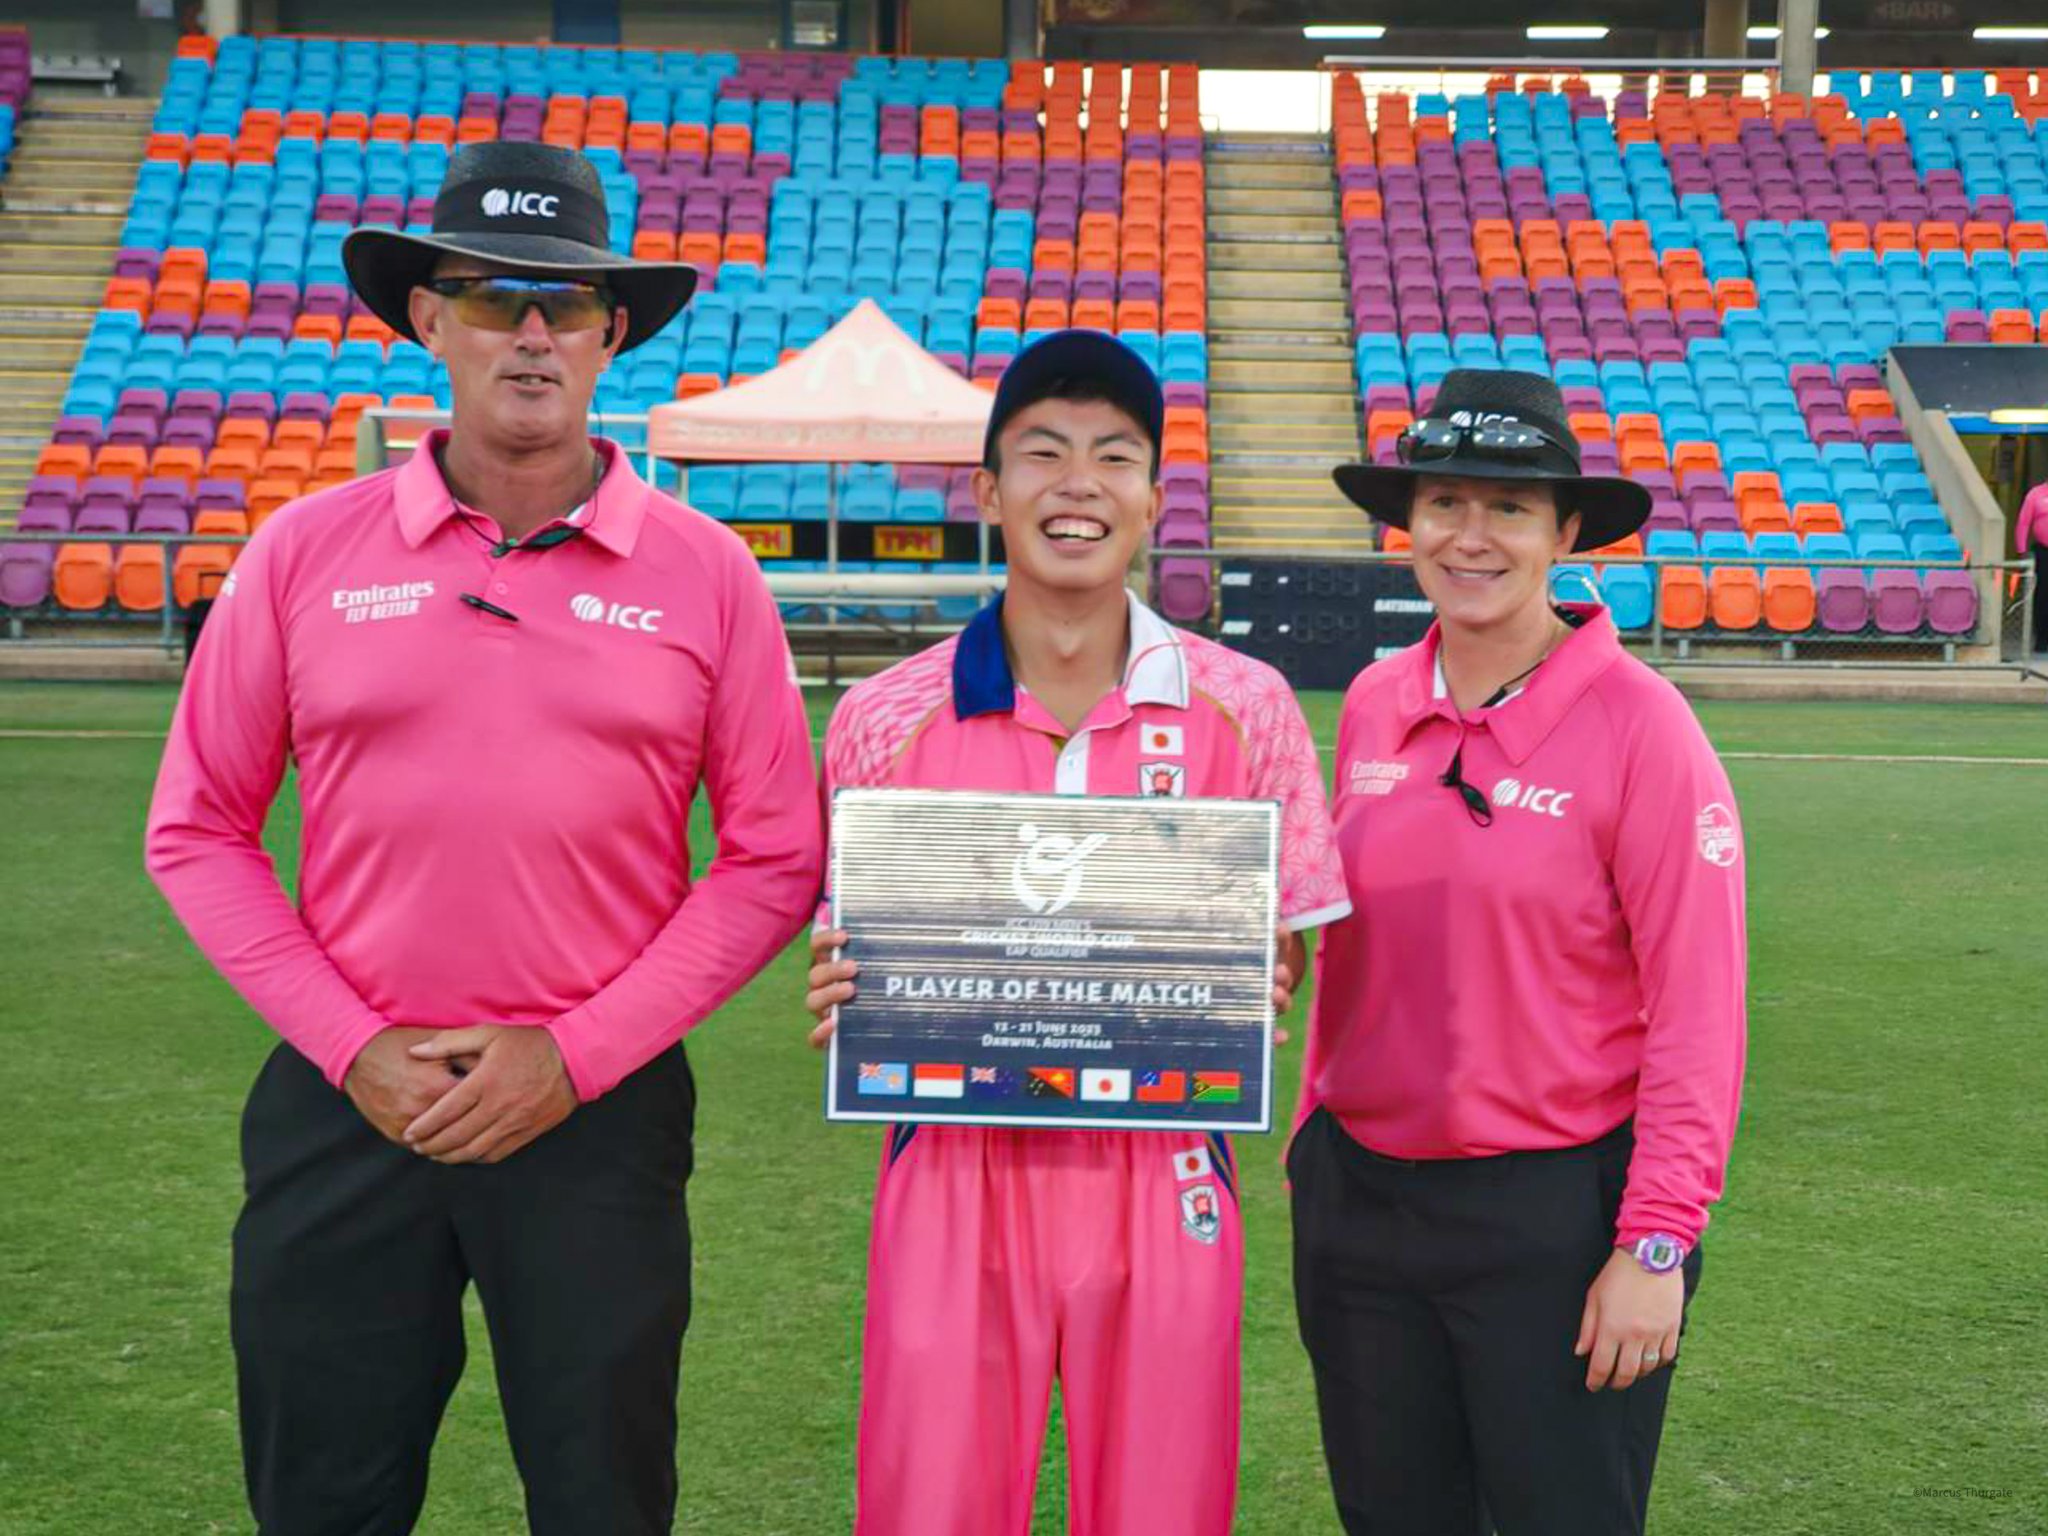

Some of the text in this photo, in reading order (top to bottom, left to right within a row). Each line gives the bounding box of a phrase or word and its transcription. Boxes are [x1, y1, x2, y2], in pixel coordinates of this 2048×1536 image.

[510, 190, 560, 217] ICC
[332, 580, 435, 609] Emirates
[607, 602, 664, 632] ICC
[1518, 784, 1574, 818] ICC
[961, 930, 1035, 946] CRICKET
[886, 976, 1213, 1006] PLAYER OF THE MATCH
